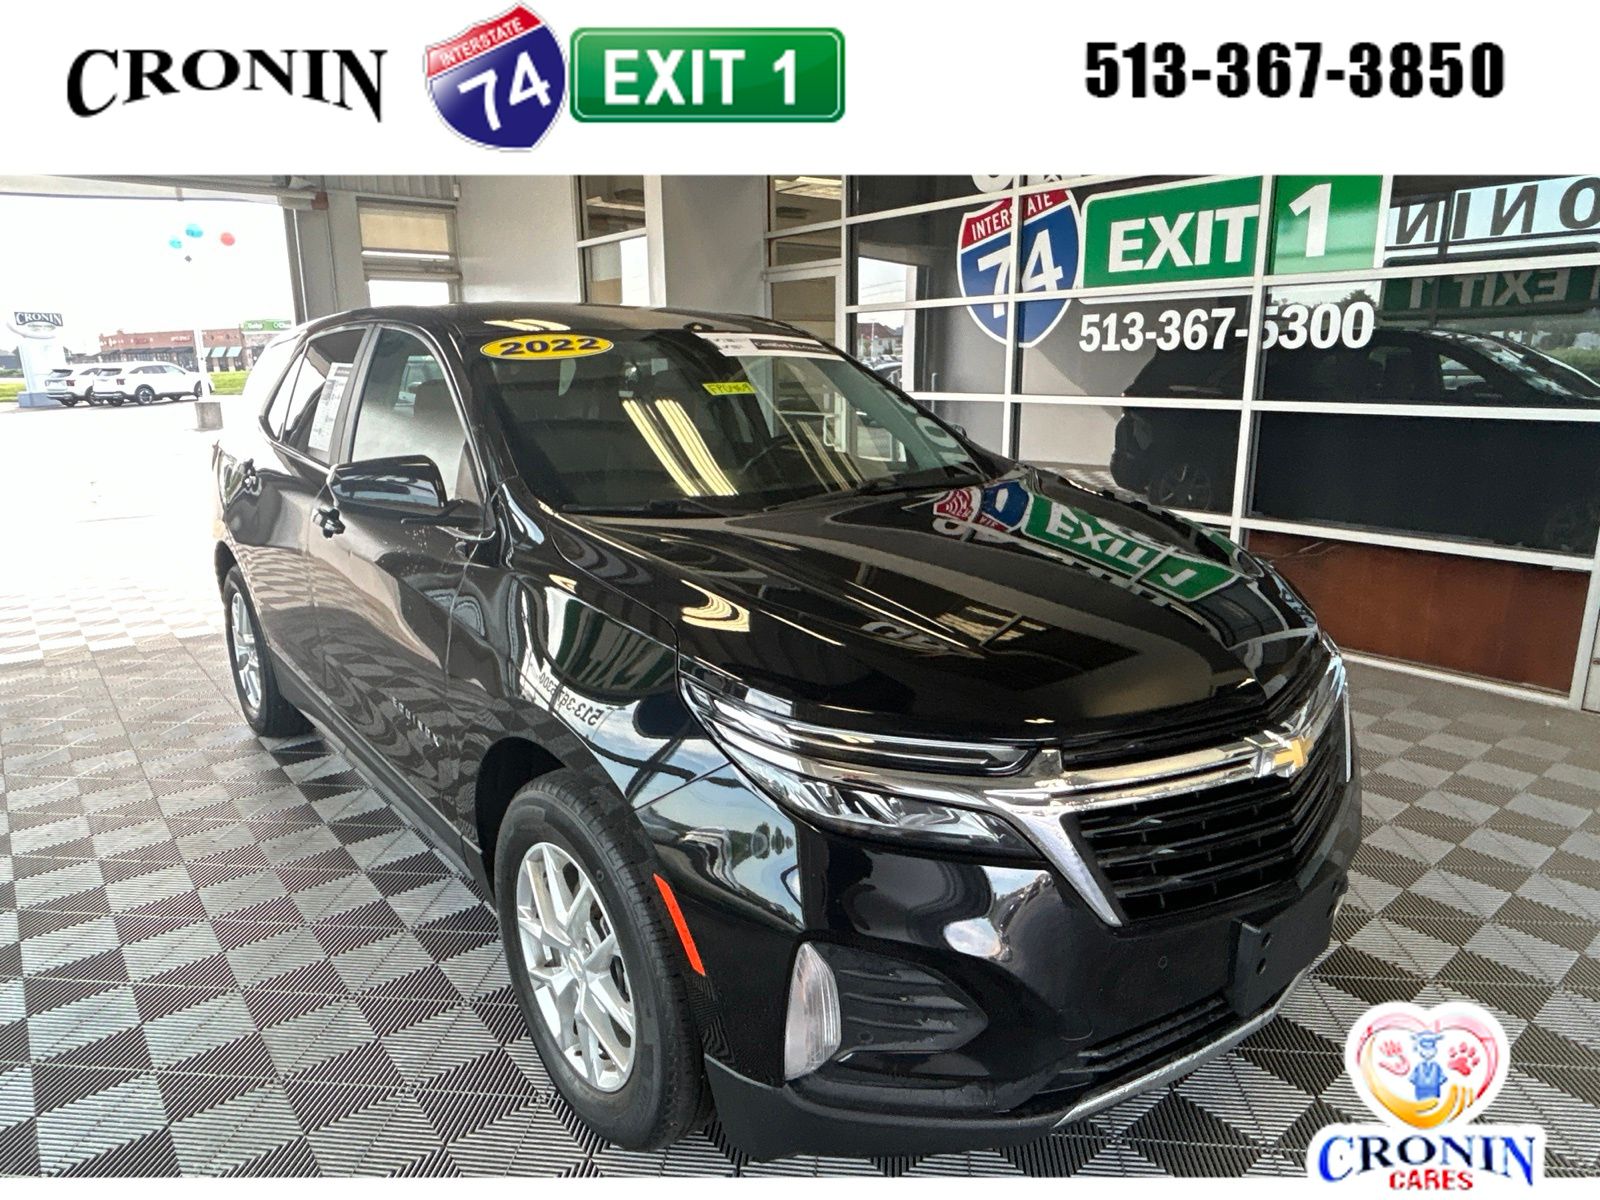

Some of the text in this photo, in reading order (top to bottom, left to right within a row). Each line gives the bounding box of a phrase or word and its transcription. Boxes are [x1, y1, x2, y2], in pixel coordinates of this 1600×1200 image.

[971, 193, 1053, 241] INTERATE
[1108, 183, 1332, 273] EXIT 1
[977, 229, 1064, 319] 74
[15, 312, 63, 326] CRONIN
[1079, 301, 1375, 352] 513-367-5300
[500, 338, 602, 356] 2022
